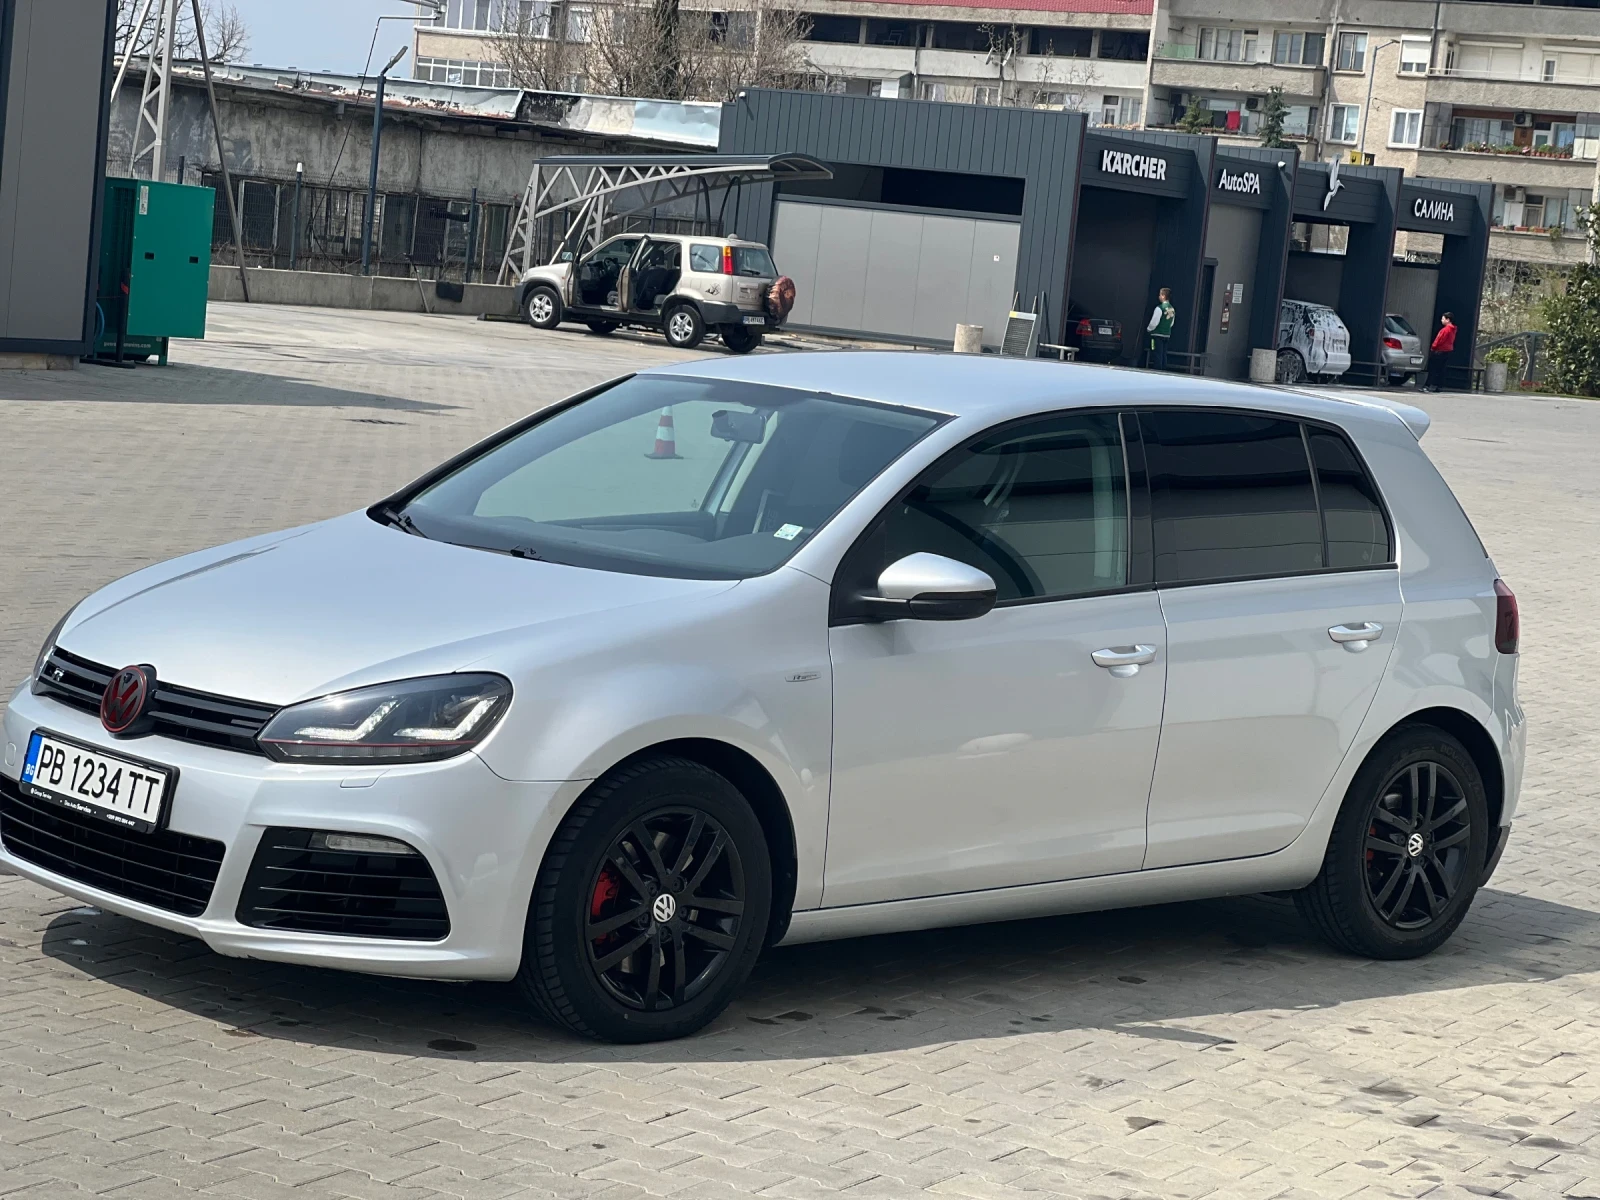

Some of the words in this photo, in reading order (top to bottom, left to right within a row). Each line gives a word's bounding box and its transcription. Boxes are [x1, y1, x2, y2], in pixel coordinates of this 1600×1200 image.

[1102, 149, 1167, 181] KÄRCHER
[1218, 168, 1260, 195] AutoSPA
[1414, 198, 1454, 222] САЛИНА
[25, 763, 35, 776] BG
[37, 744, 66, 786] PB
[70, 754, 123, 804] 1234
[127, 770, 160, 814] TT
